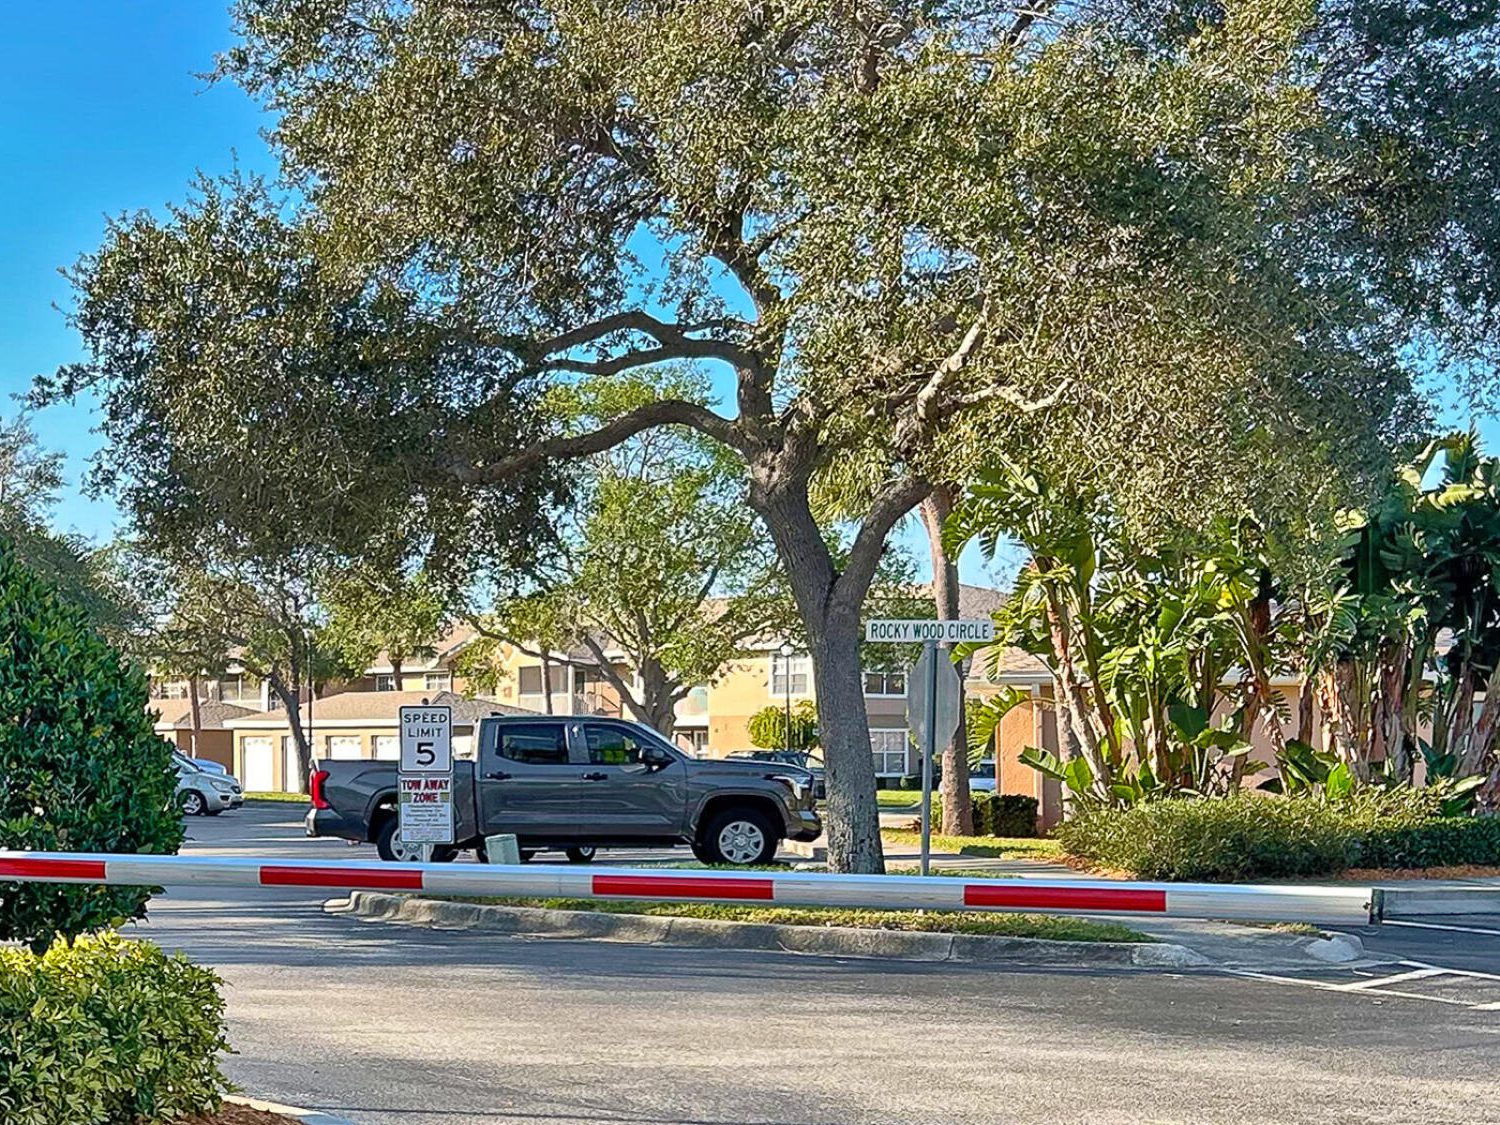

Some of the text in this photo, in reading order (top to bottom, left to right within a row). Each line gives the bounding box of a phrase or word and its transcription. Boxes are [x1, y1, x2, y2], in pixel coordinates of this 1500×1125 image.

[870, 623, 989, 639] ROCKY WOOD CIRCLE
[404, 713, 447, 723] SPEED
[408, 728, 443, 738] LIMIT
[416, 742, 436, 765] 5
[401, 779, 450, 790] TOW AWAY
[413, 792, 438, 803] ZONE
